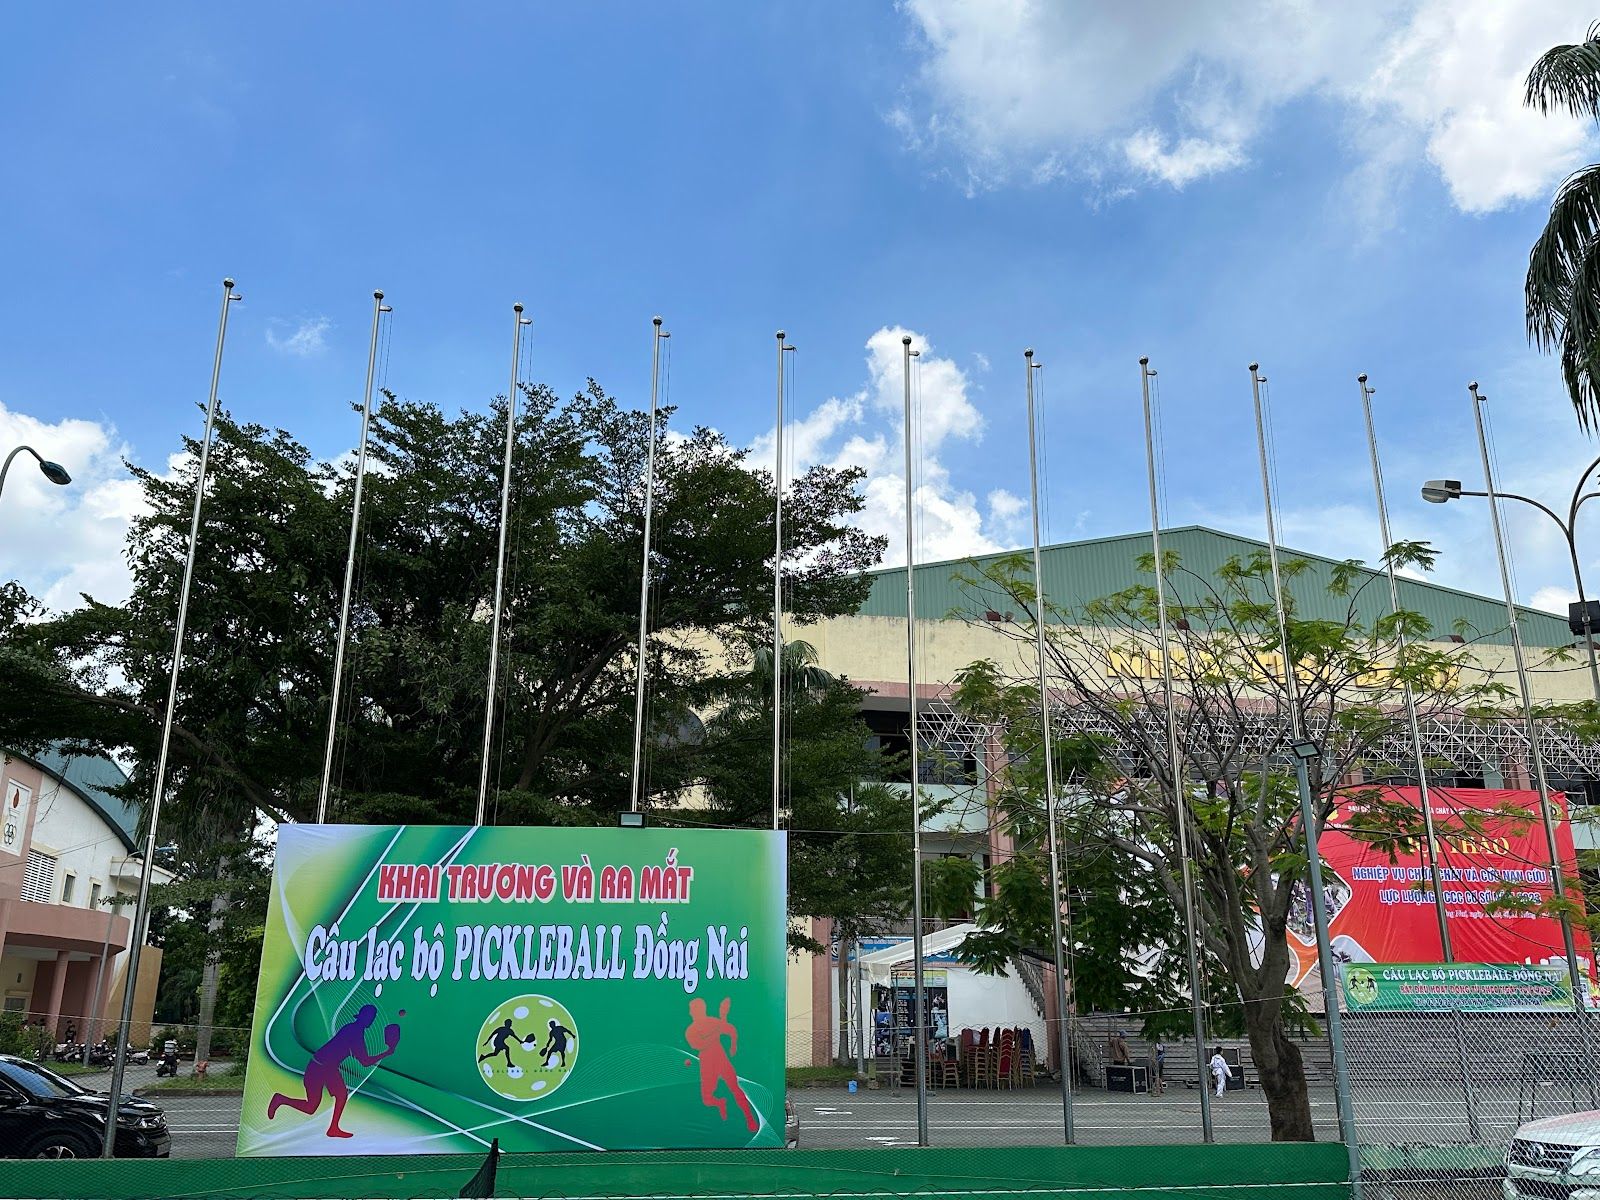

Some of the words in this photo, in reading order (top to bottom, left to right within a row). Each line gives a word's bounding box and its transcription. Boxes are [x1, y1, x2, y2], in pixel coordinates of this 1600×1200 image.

[377, 862, 444, 902] KHAI
[446, 862, 556, 902] TRƯƠNG
[562, 853, 595, 902] VÀ
[599, 864, 633, 902] RA
[638, 848, 695, 904] MẮT
[1352, 865, 1390, 883] NGHIỆP
[1391, 868, 1406, 884] VỤ
[1464, 866, 1479, 882] VÀ
[1526, 867, 1547, 884] CỨU
[1379, 889, 1401, 905] LỰC
[304, 922, 357, 983] Câu
[366, 924, 404, 998] lạc
[411, 921, 445, 998] bộ
[452, 924, 628, 982] PICKLEBALL
[632, 911, 701, 995] Đồng
[706, 924, 750, 983] Nai
[1407, 968, 1430, 983] LẠC
[1430, 966, 1446, 983] BỘ
[1447, 968, 1512, 981] PICKLEBALL
[1544, 970, 1563, 982] NAI
